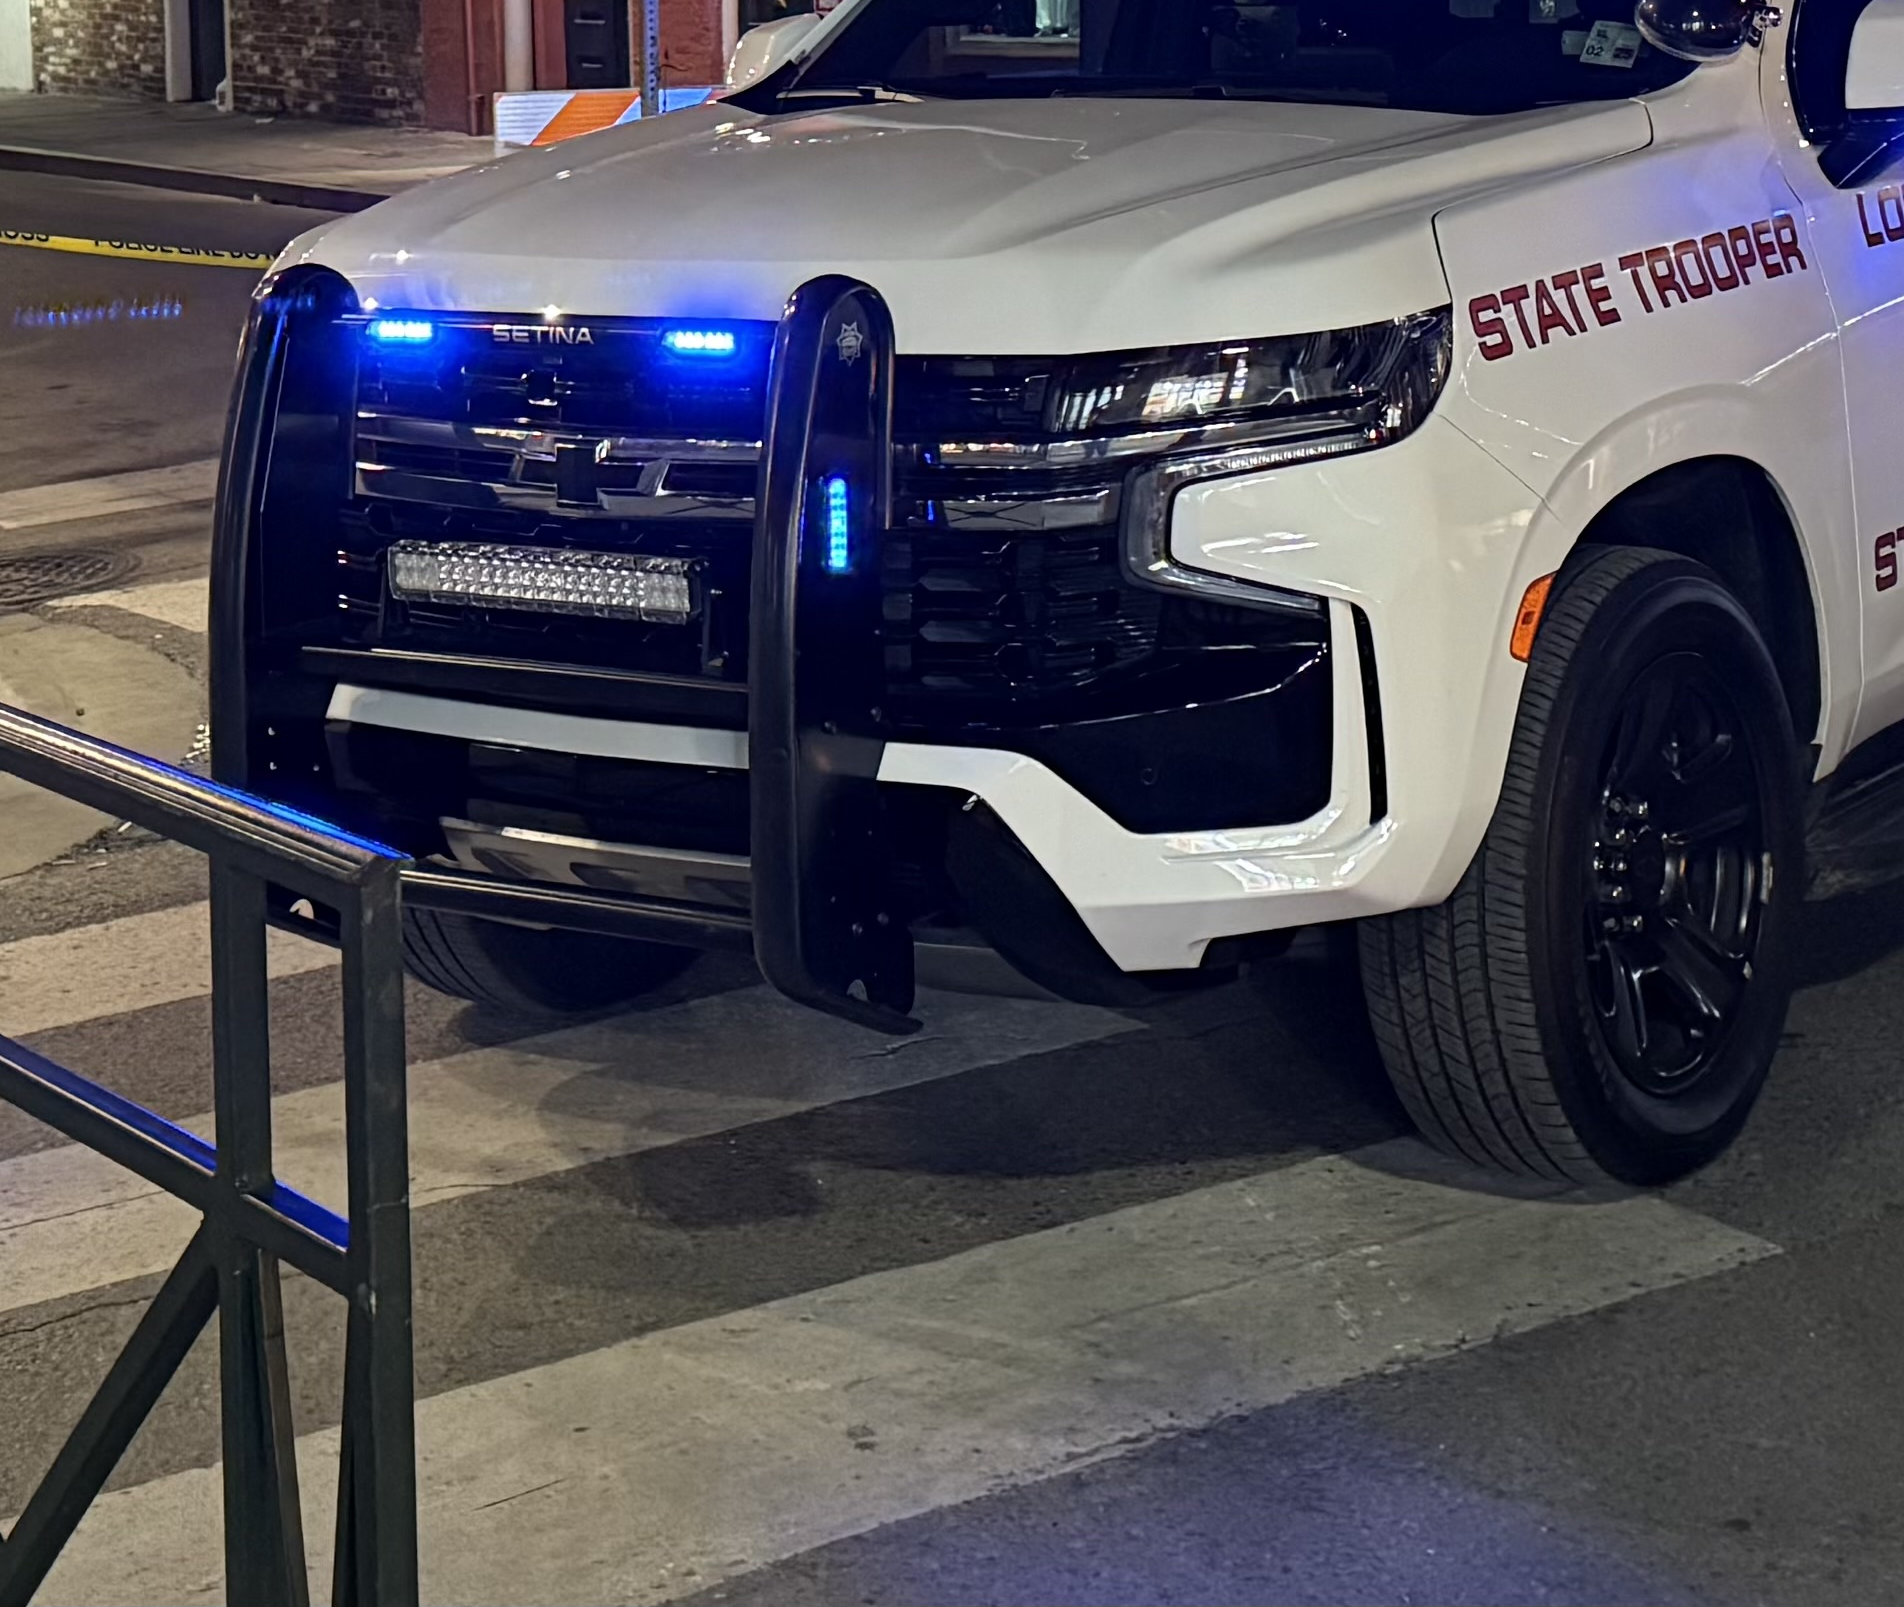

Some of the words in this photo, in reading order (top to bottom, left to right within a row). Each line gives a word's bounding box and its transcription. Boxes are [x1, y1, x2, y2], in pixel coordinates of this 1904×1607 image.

[1468, 262, 1622, 362] STATE
[1618, 213, 1808, 314] TROOPER
[491, 324, 595, 347] SETINA
